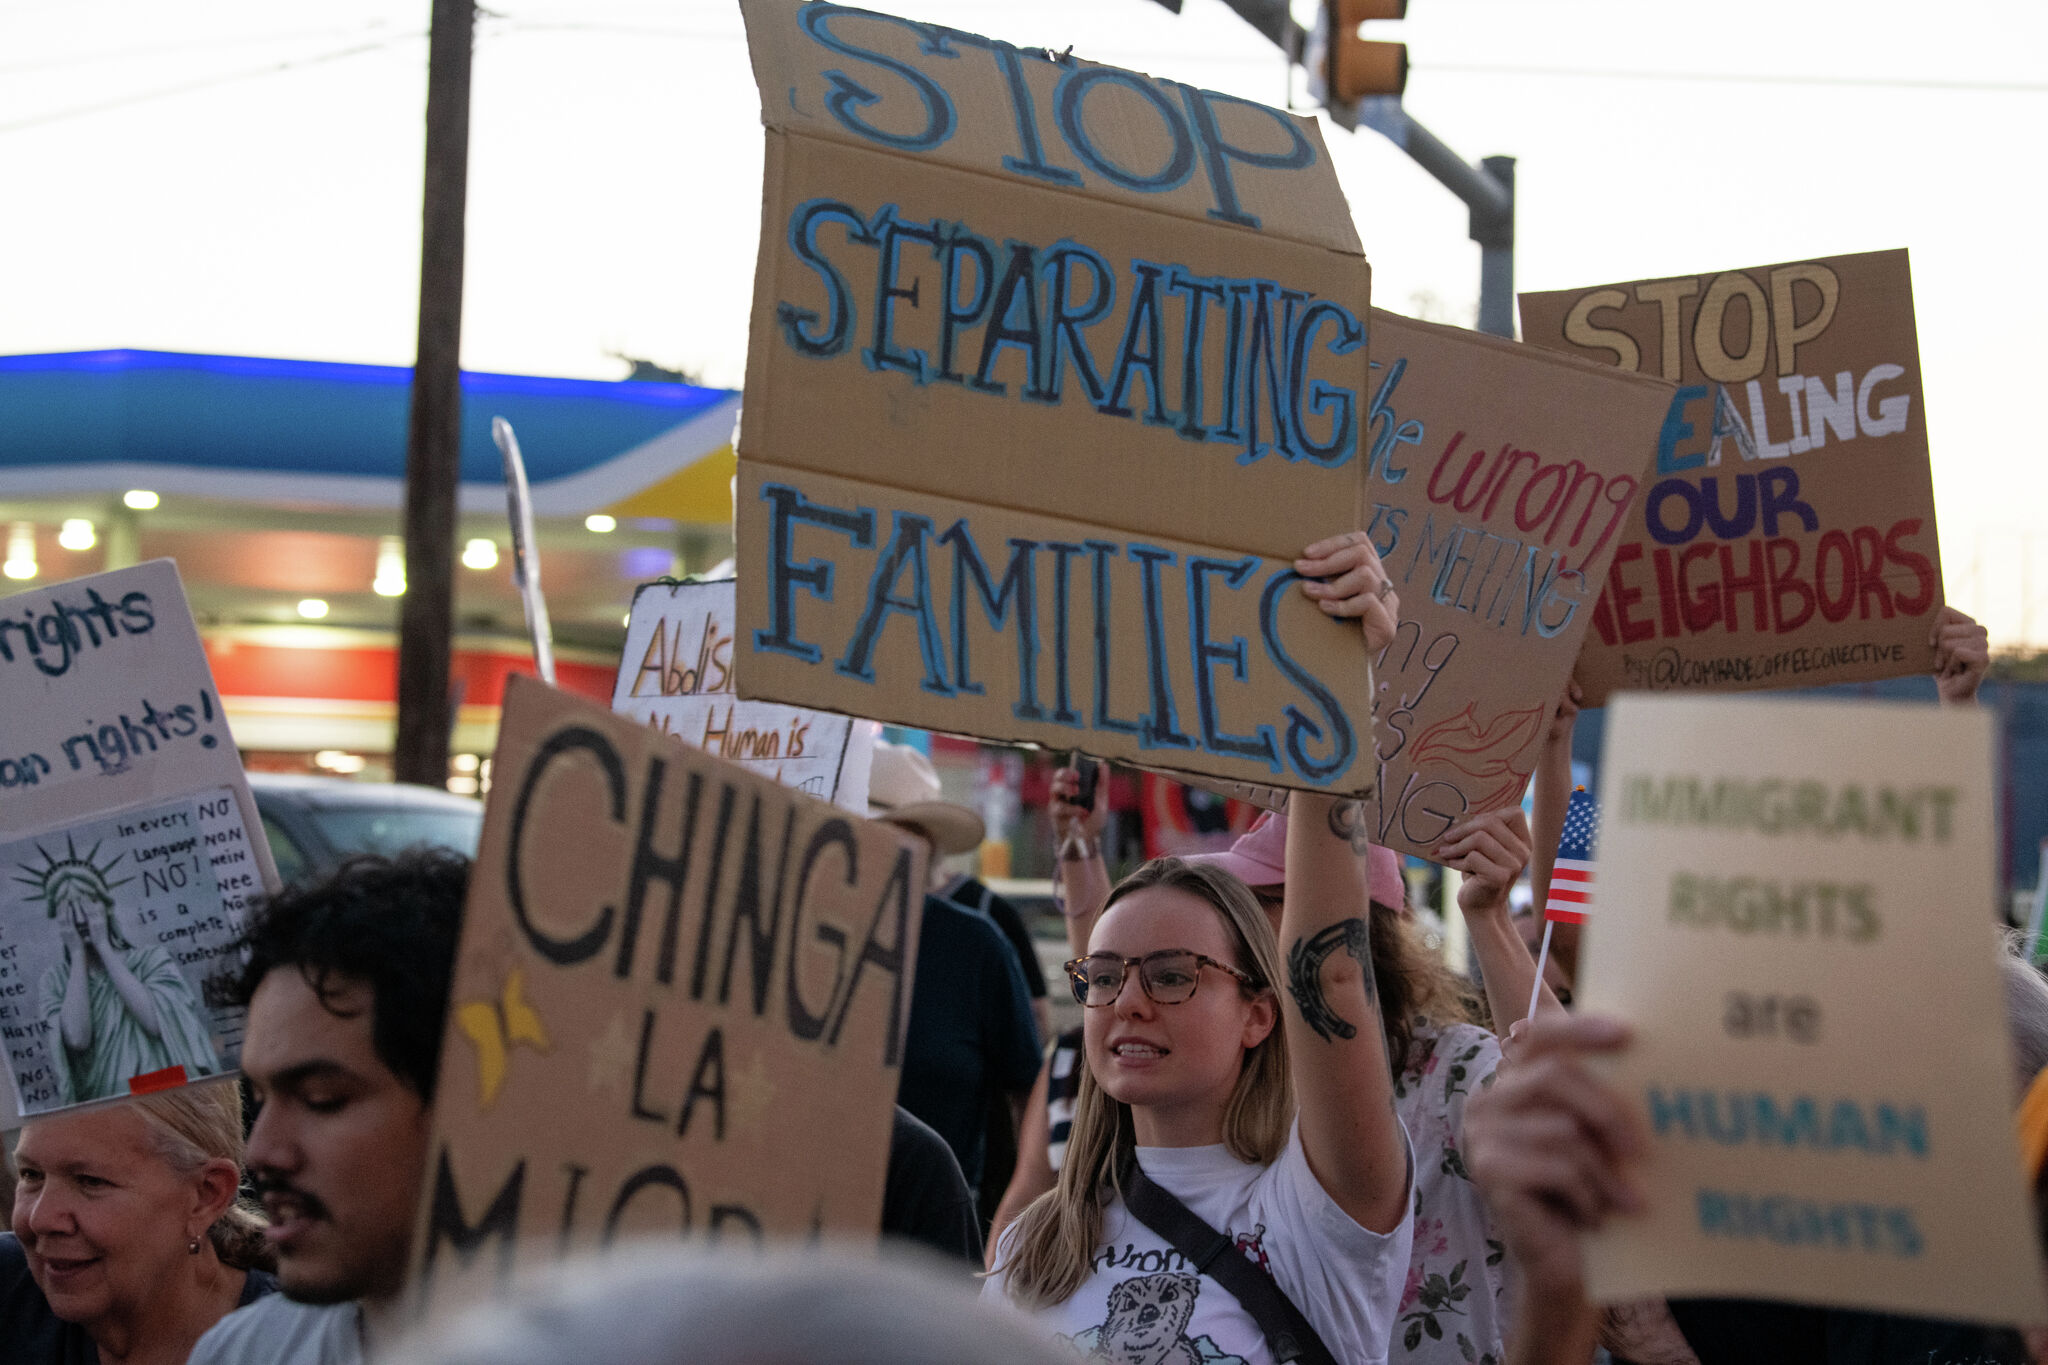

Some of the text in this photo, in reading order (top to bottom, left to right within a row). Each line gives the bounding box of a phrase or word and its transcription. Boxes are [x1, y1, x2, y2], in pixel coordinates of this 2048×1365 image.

[798, 1, 1316, 229] STOP
[777, 198, 1366, 469] SEPARATING
[1562, 261, 1840, 384] STOP
[1645, 466, 1819, 546] OUR
[753, 482, 1361, 786] FAMILIES
[61, 689, 218, 776] rights!
[786, 716, 810, 758] is
[140, 811, 189, 833] every
[199, 799, 229, 820] NO
[1622, 774, 1959, 846] IMMIGRANT
[143, 855, 200, 898] NO!
[508, 725, 914, 1069] CHINGA
[1668, 870, 1881, 945] RIGHTS
[1723, 991, 1824, 1045] are
[630, 1005, 728, 1141] LA
[1646, 1084, 1931, 1160] HUMAN
[1694, 1186, 1926, 1260] RIGHTS
